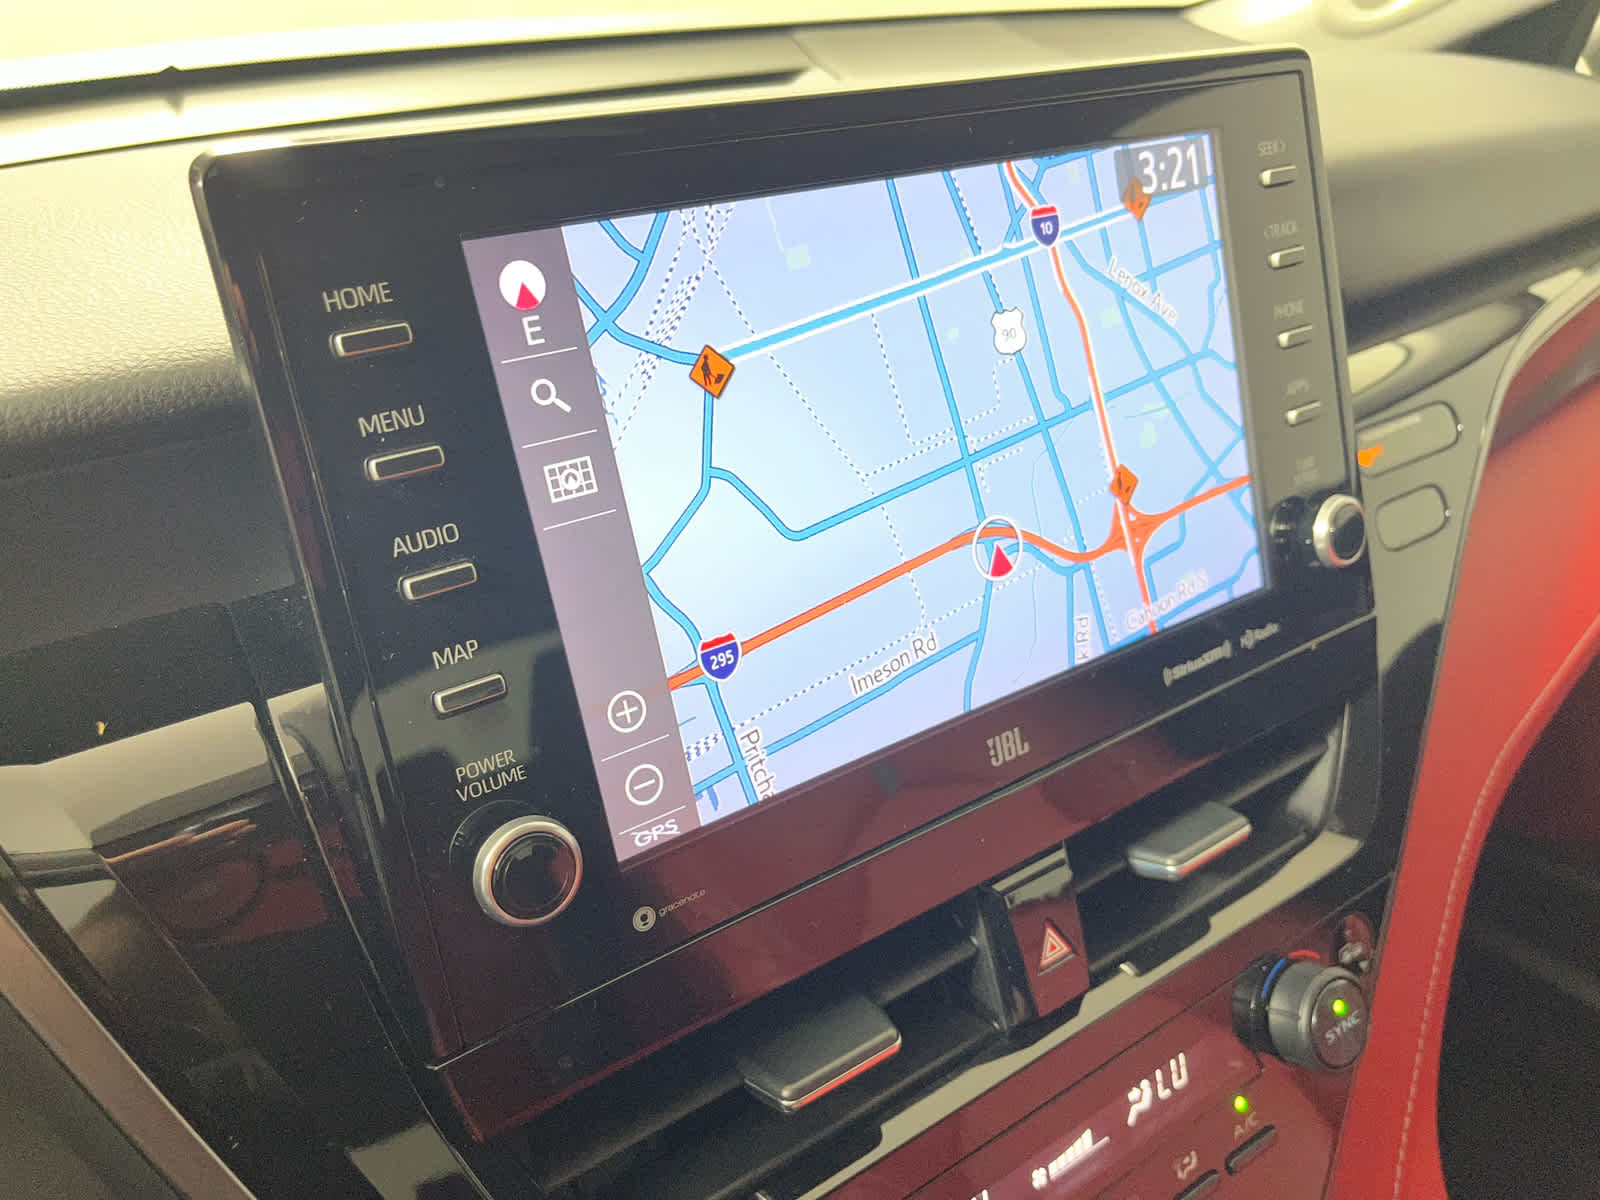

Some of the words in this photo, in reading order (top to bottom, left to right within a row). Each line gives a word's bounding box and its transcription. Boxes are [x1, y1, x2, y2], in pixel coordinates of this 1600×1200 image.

[1138, 143, 1200, 193] 3:21
[1040, 222, 1054, 235] 10
[322, 282, 393, 312] HOME
[521, 315, 545, 346] E
[1001, 327, 1017, 342] 90
[358, 404, 424, 437] MENU
[393, 523, 460, 557] AUDIO
[432, 639, 479, 669] MAP
[709, 650, 735, 671] 295
[851, 653, 911, 695] Imeson
[911, 632, 937, 661] Rd
[986, 728, 1031, 767] JBL
[455, 749, 517, 783] POWER
[456, 765, 528, 802] VOLUME
[1324, 1010, 1361, 1044] SYNC
